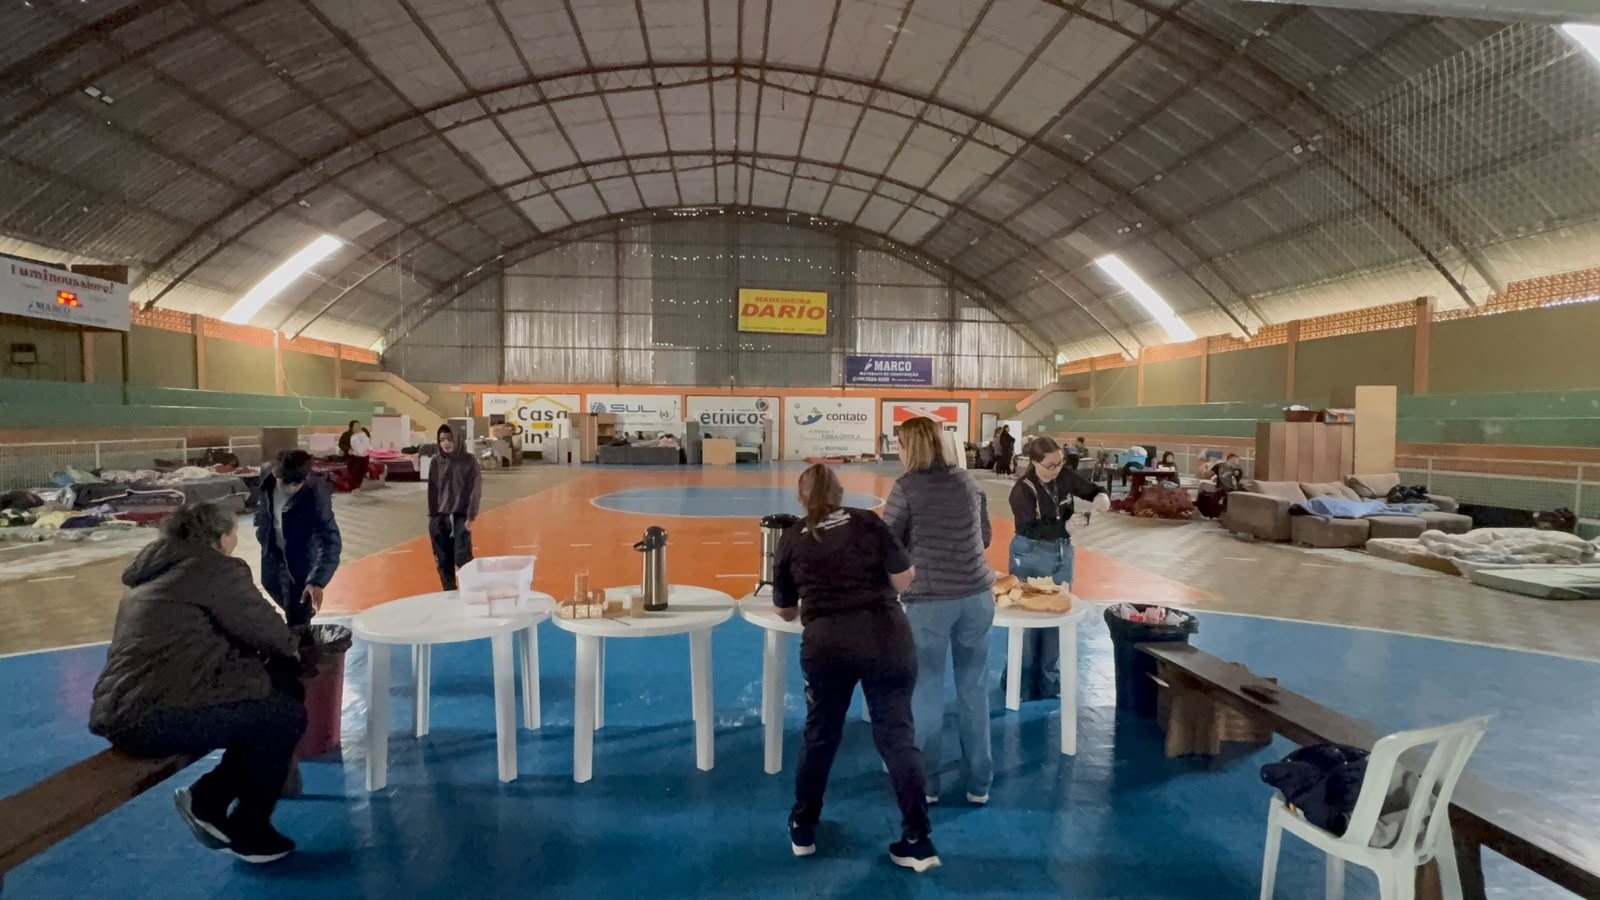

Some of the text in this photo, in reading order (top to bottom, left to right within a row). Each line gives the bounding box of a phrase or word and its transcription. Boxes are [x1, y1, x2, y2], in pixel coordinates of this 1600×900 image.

[741, 303, 825, 320] DARIO
[874, 360, 912, 372] MARCO
[517, 406, 568, 421] Casa
[609, 403, 657, 413] SUL
[826, 412, 868, 422] contato
